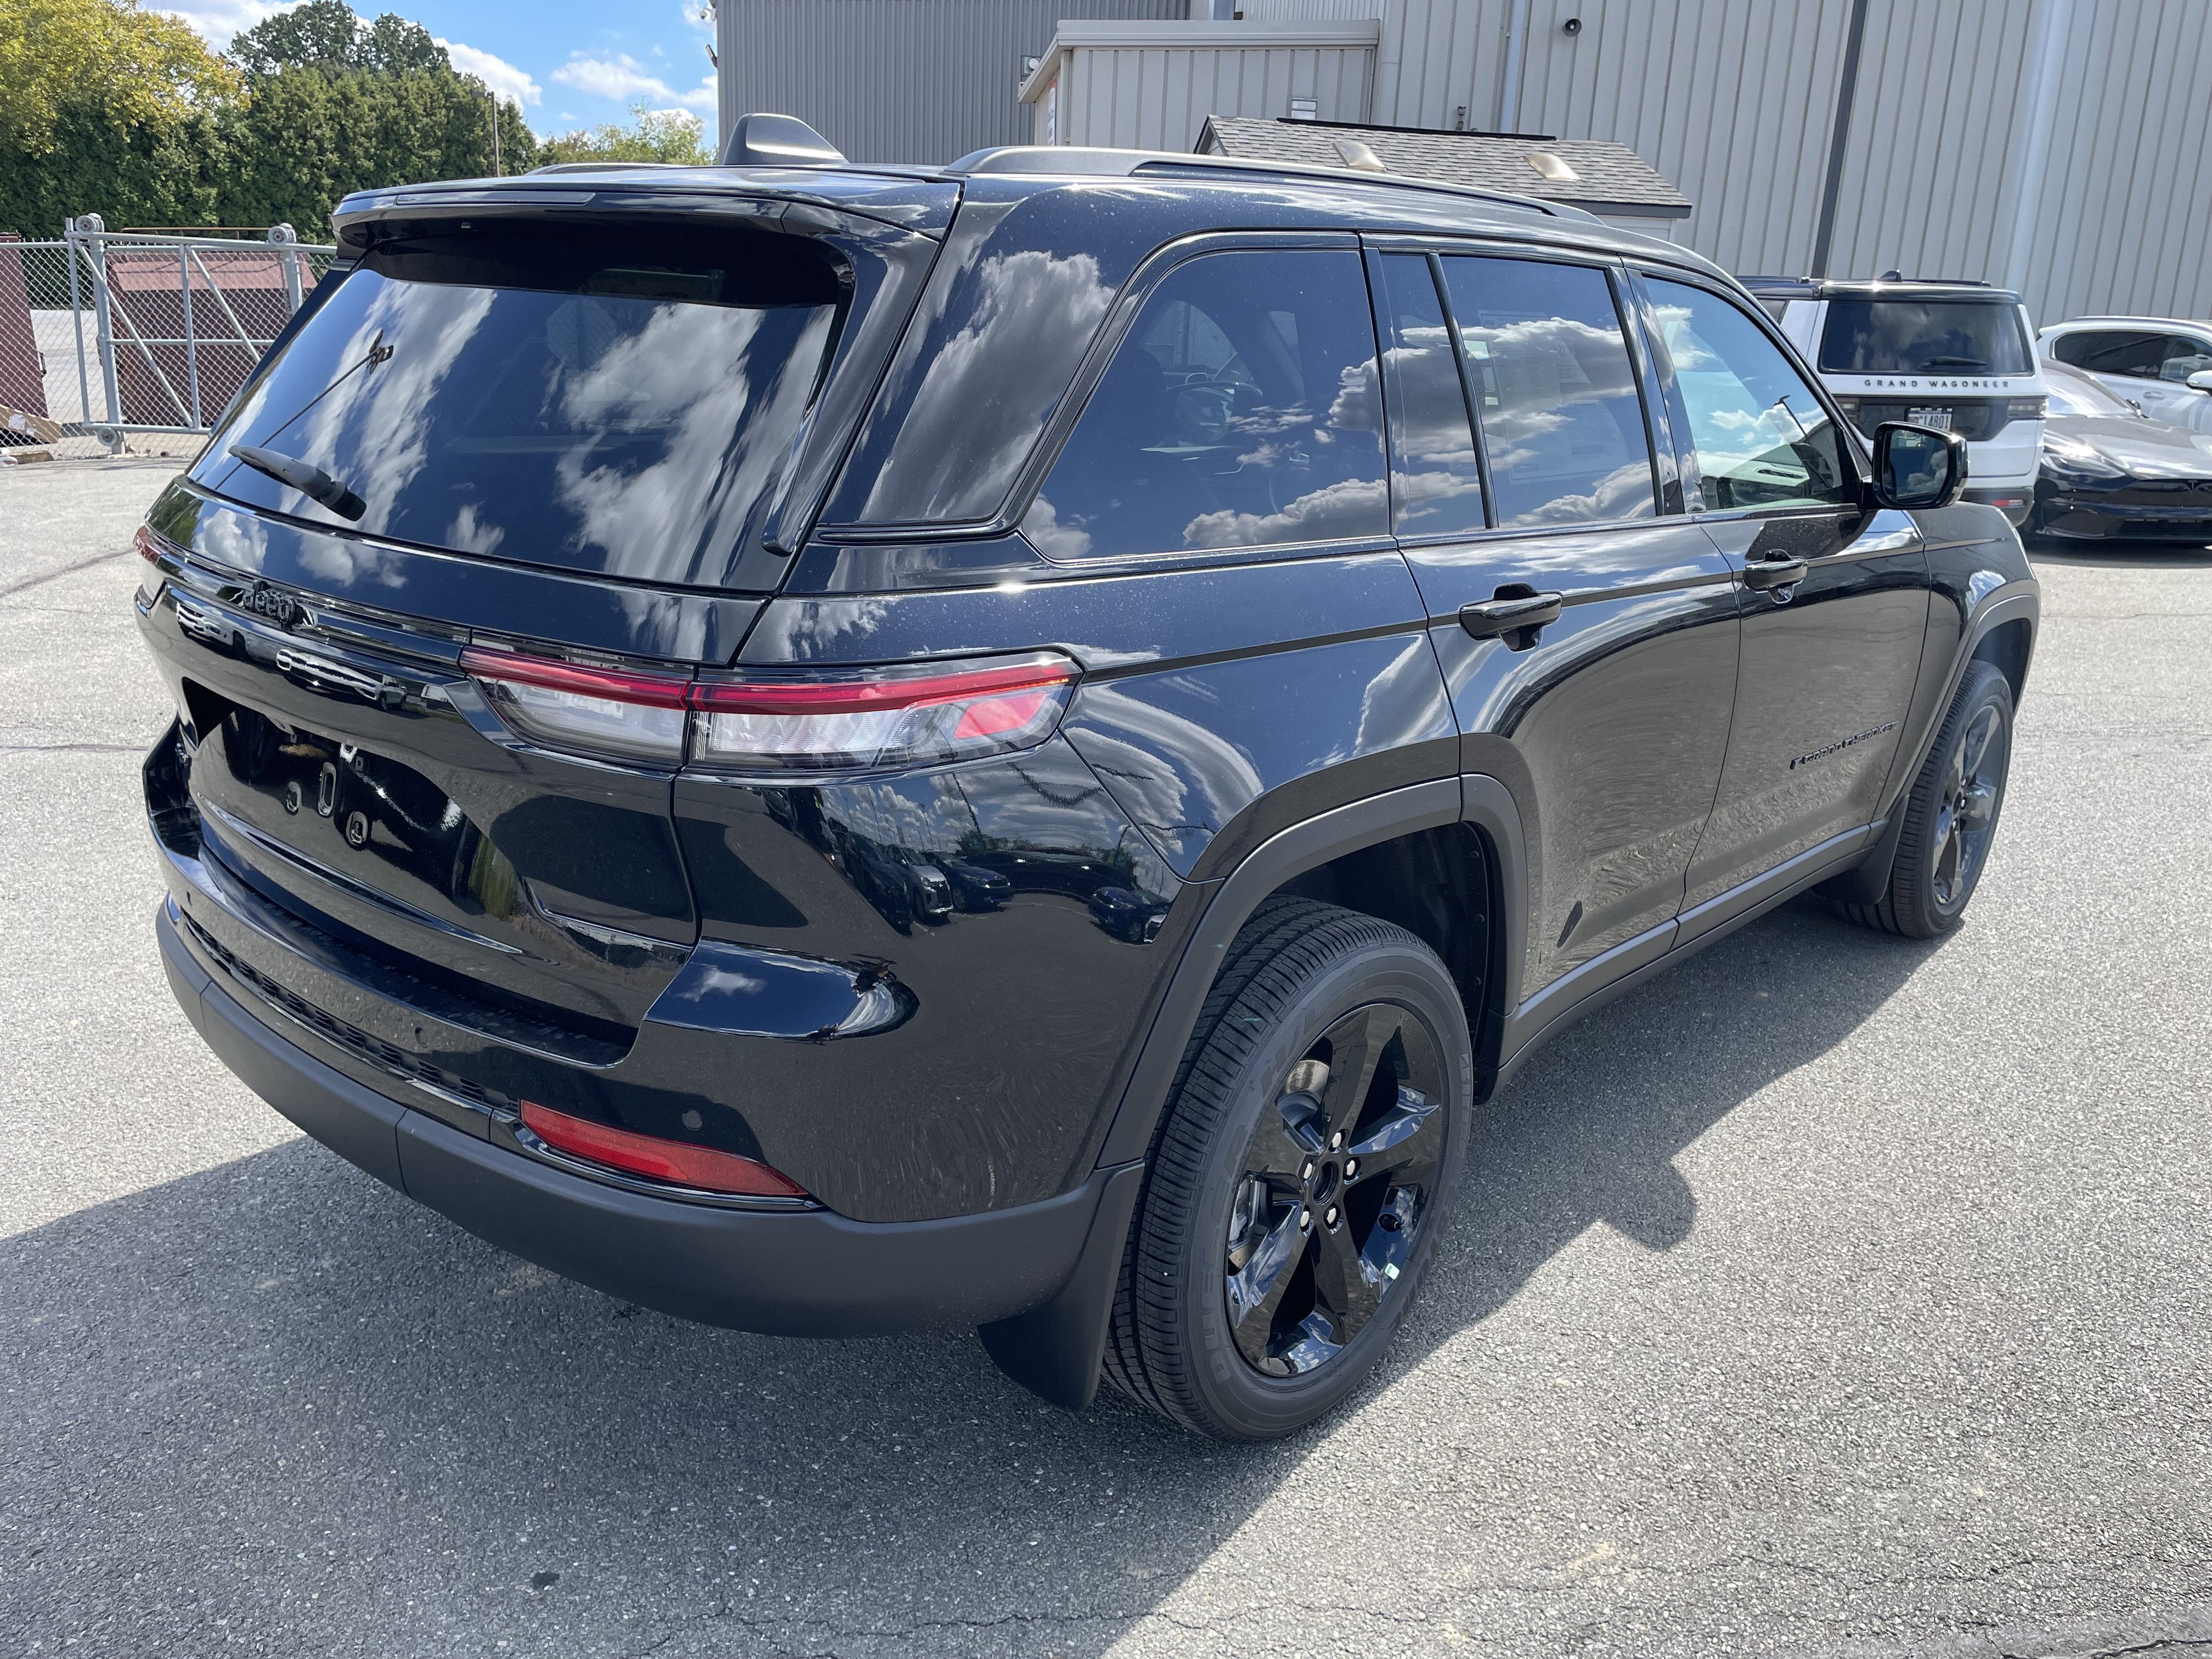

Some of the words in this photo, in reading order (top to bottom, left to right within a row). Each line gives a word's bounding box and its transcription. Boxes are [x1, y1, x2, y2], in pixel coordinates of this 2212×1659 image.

[1864, 379, 1918, 387] GRAND
[242, 580, 296, 630] Jeep
[1802, 742, 1842, 764] GRAND
[1198, 1122, 1249, 1392] DUELER
